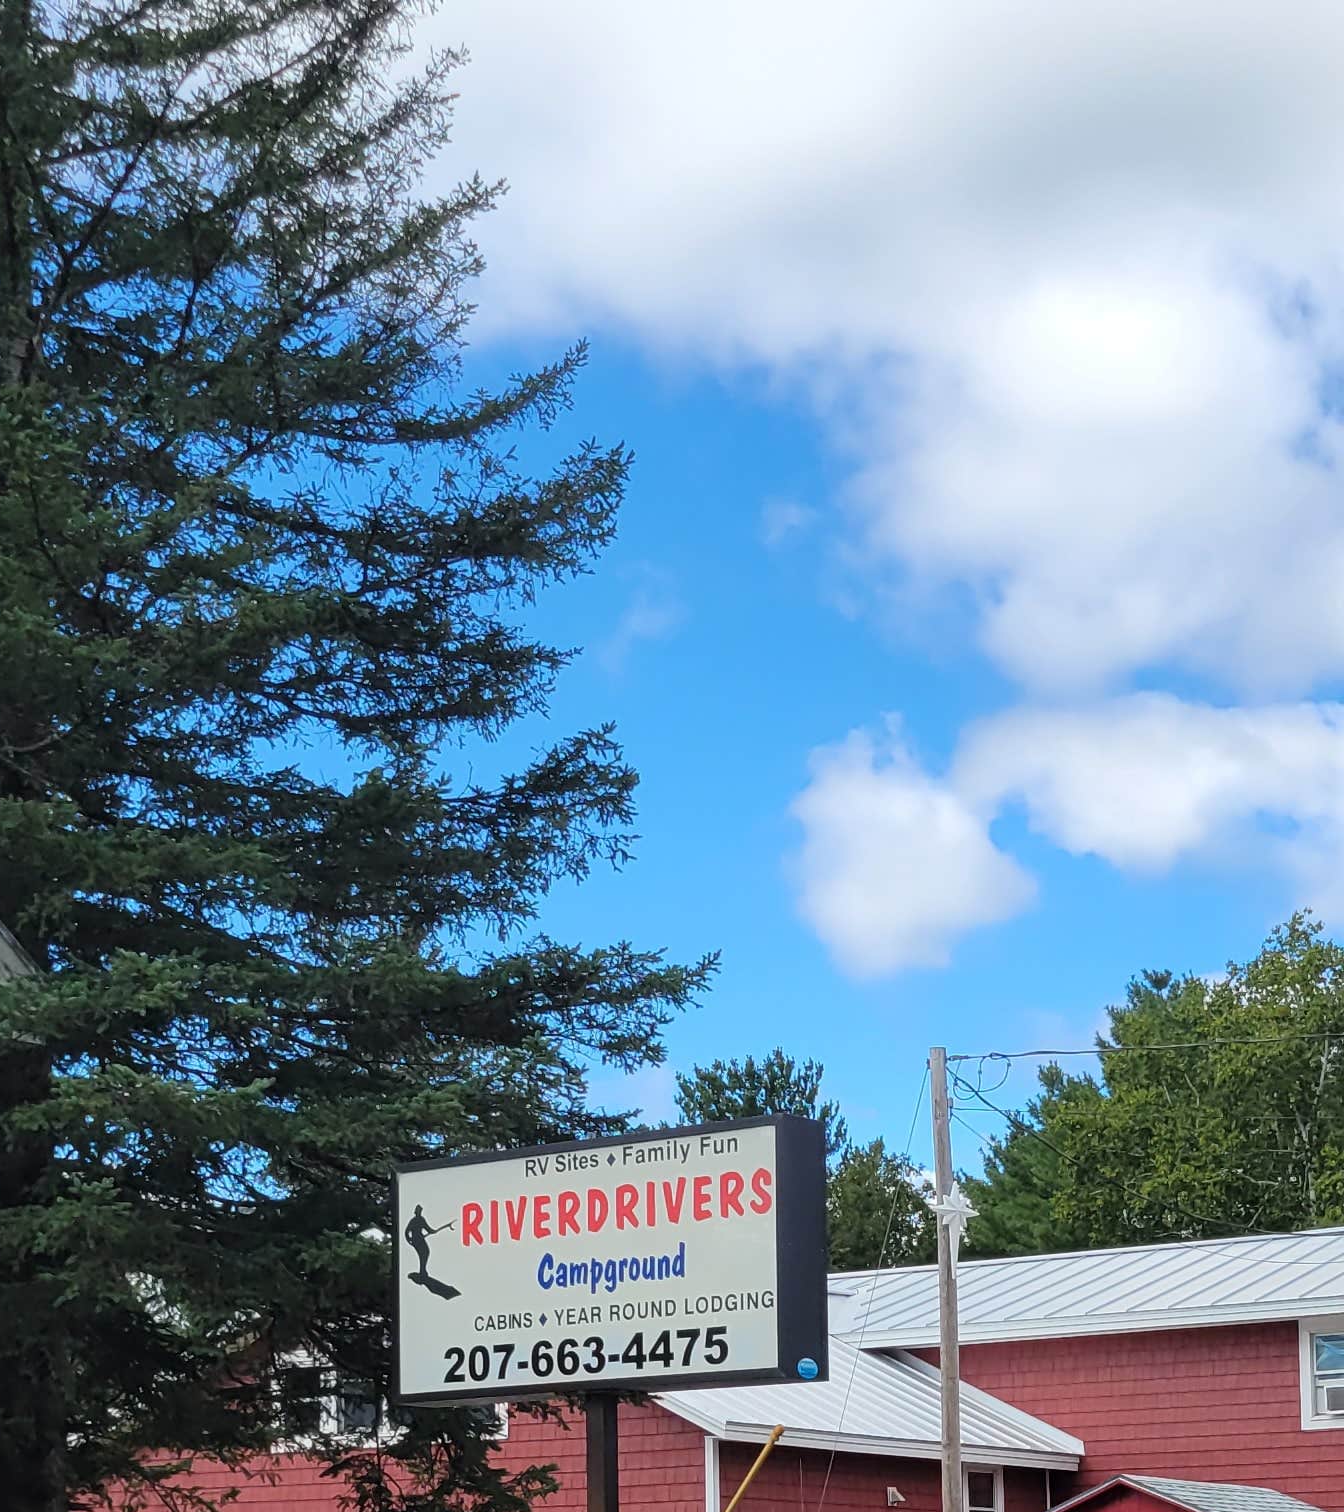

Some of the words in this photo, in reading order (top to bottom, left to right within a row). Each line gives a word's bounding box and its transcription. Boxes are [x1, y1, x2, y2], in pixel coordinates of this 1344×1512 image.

[524, 1154, 550, 1177] RV
[554, 1149, 599, 1172] Sites
[622, 1138, 690, 1165] Family
[700, 1135, 738, 1156] Fun
[462, 1168, 772, 1247] RIVERDRIVERS
[537, 1242, 686, 1294] Campground
[474, 1312, 533, 1332] CABINS
[555, 1307, 602, 1326] YEAR
[610, 1300, 676, 1321] ROUND
[684, 1291, 775, 1315] LODGING
[444, 1326, 729, 1383] 207-663-4475
